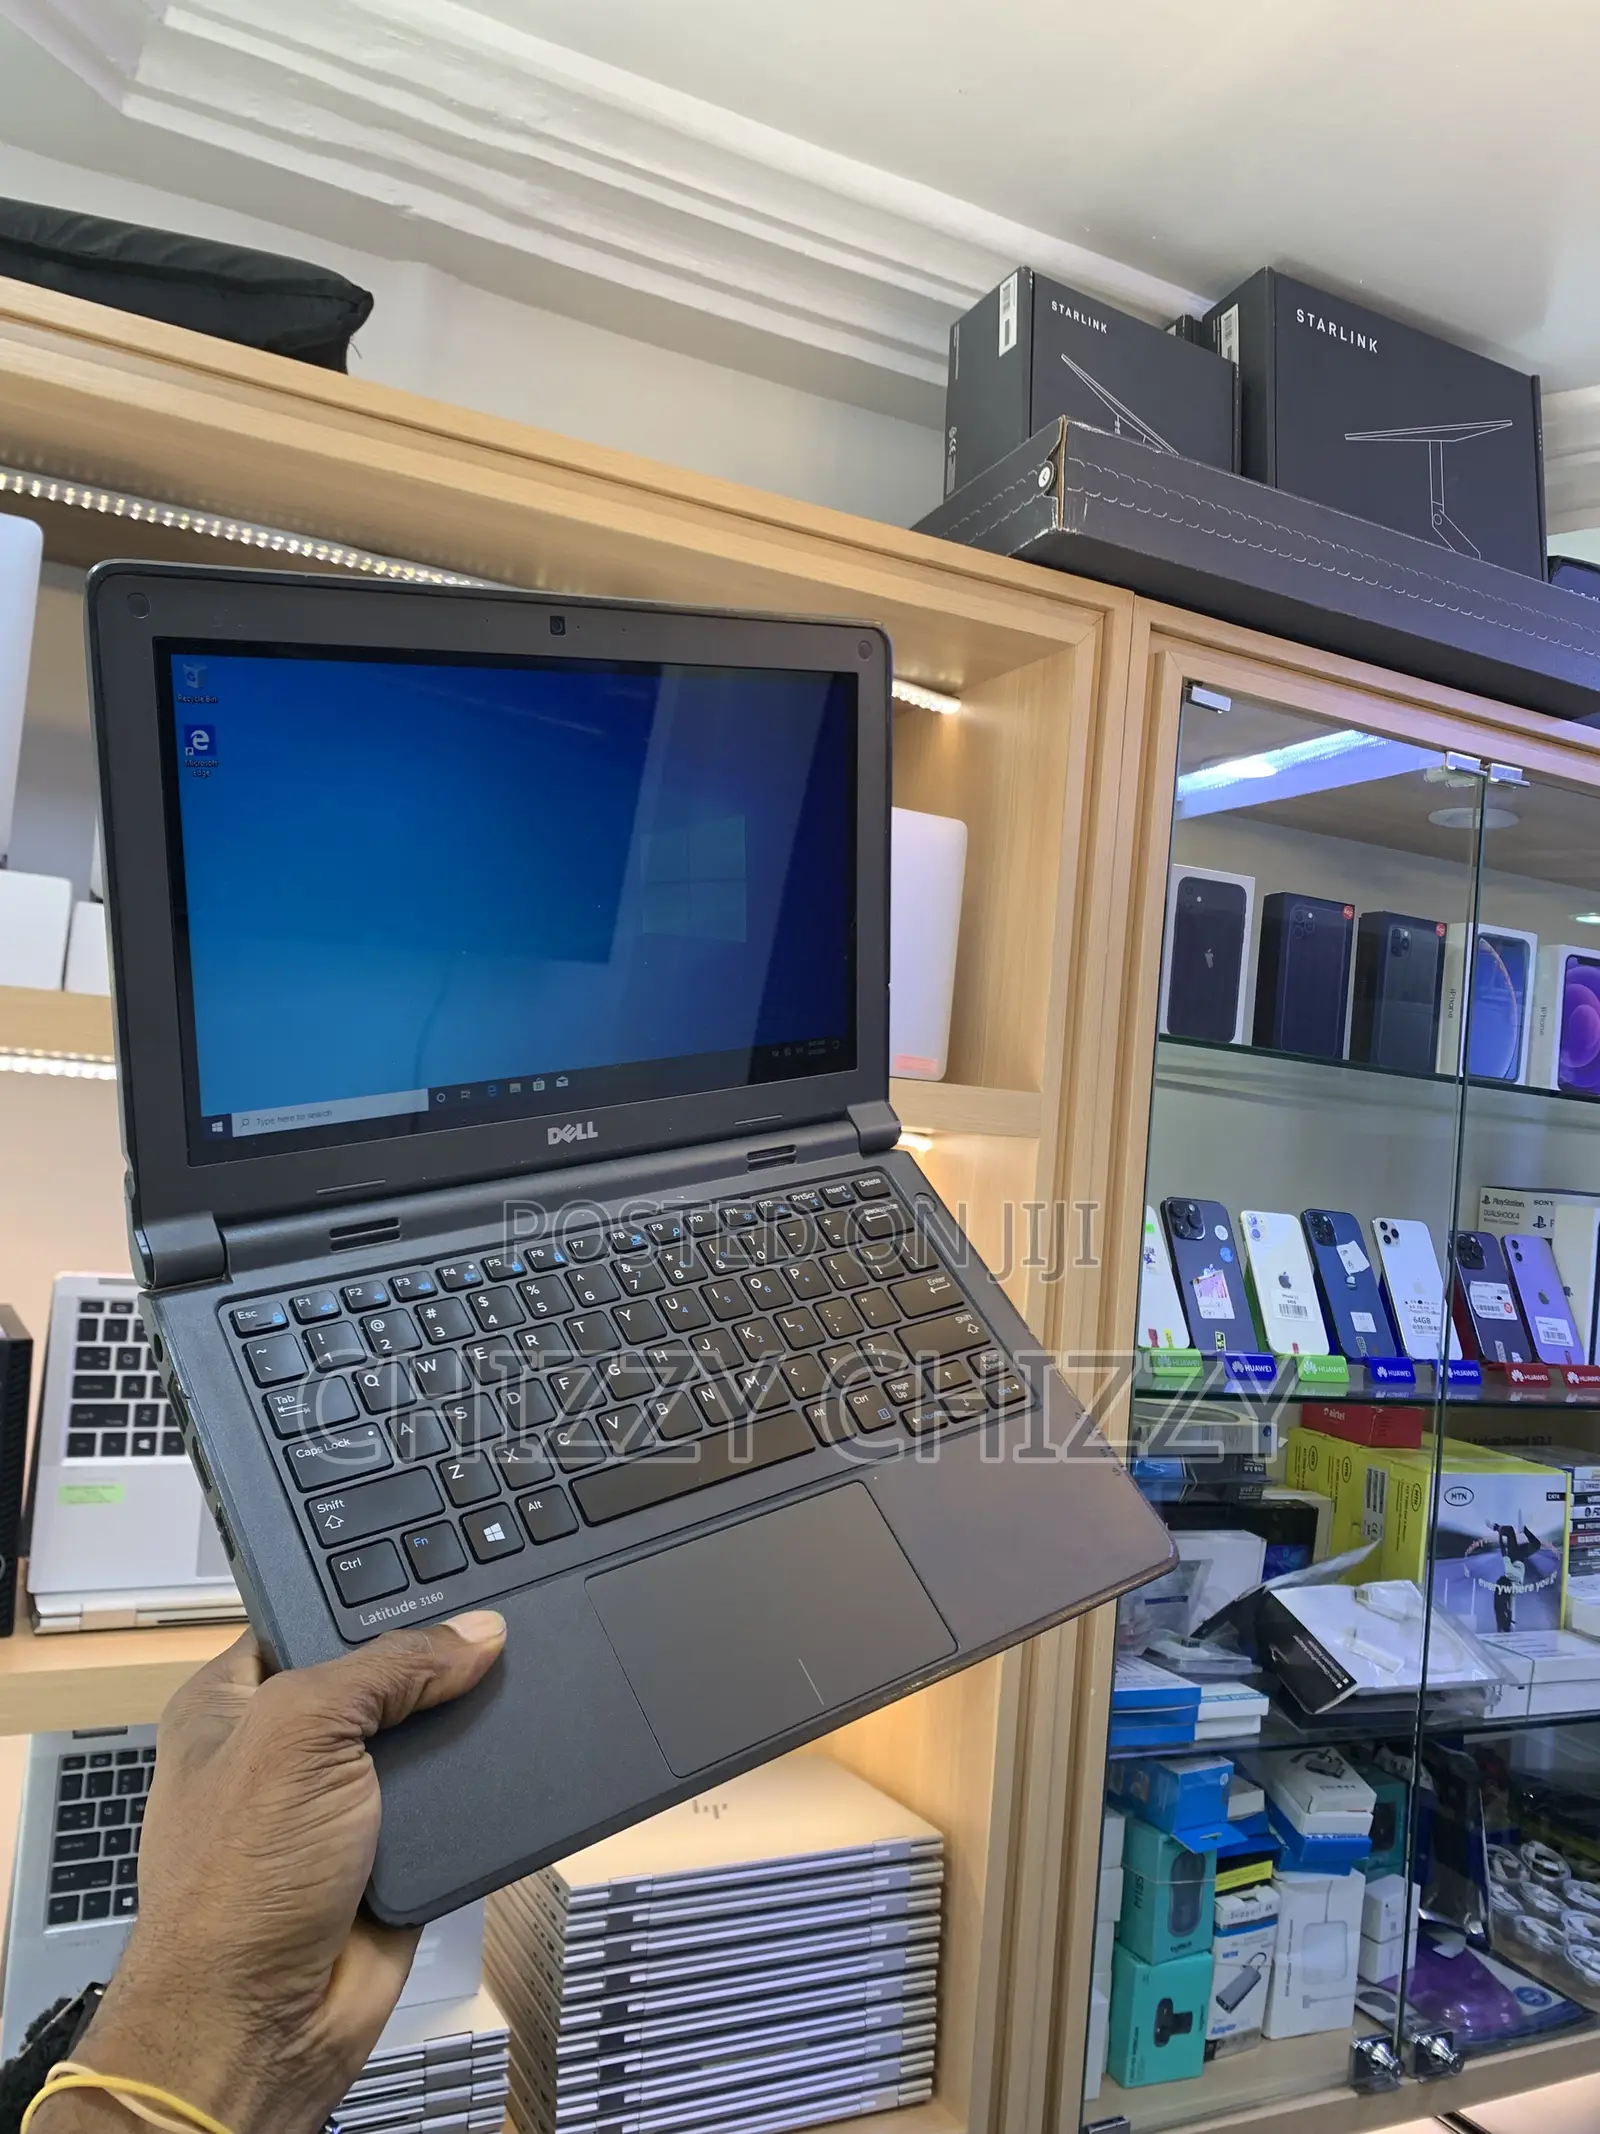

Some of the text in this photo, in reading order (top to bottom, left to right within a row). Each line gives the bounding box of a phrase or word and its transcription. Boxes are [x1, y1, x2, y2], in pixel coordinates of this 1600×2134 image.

[1051, 300, 1108, 334] STARLINK
[1296, 308, 1378, 354] STARLINK
[1447, 988, 1457, 1019] iPhone
[1539, 1006, 1548, 1036] iPhone
[256, 1108, 333, 1129] Type here to search
[547, 1121, 599, 1145] DELL
[859, 1178, 882, 1187] Delete
[825, 1184, 847, 1194] Insert
[791, 1192, 816, 1201] PrtScr
[758, 1200, 773, 1209] F12
[1492, 1197, 1525, 1208] PlayStation
[724, 1208, 738, 1216] F11
[688, 1215, 703, 1224] F10
[651, 1223, 664, 1232] F9
[612, 1231, 625, 1240] F8
[572, 1240, 584, 1249] F7
[531, 1249, 544, 1258] F6
[487, 1258, 501, 1268] F5
[715, 1259, 726, 1269] 9
[442, 1267, 456, 1277] F4
[674, 1269, 684, 1279] 8
[789, 1268, 799, 1280] P
[396, 1278, 410, 1287] F3
[630, 1280, 638, 1289] 7
[750, 1278, 762, 1289] O
[926, 1276, 946, 1286] Enter
[348, 1288, 363, 1297] F2
[584, 1290, 595, 1301] 6
[297, 1298, 311, 1308] F1
[537, 1302, 547, 1312] 5
[665, 1298, 678, 1310] U
[237, 1309, 258, 1321] Esc
[488, 1314, 498, 1325] 4
[620, 1309, 632, 1321] Y
[955, 1314, 974, 1324] Shift
[1413, 1316, 1431, 1325] 64GB
[573, 1321, 585, 1333] T
[782, 1317, 795, 1328] L
[434, 1327, 446, 1337] 3
[741, 1327, 755, 1339] K
[380, 1338, 392, 1350] 2
[525, 1334, 539, 1347] R
[701, 1338, 711, 1350] J
[474, 1347, 488, 1360] E
[653, 1351, 668, 1363] H
[417, 1359, 437, 1374] W
[608, 1364, 621, 1376] G
[1244, 1364, 1273, 1373] HUAWEI
[1317, 1365, 1346, 1374] HUAWEI
[1387, 1369, 1412, 1378] HUAWEI
[1453, 1369, 1480, 1377] HUAWEI
[1524, 1373, 1549, 1381] HUAWEI
[1579, 1374, 1600, 1382] HUAWE
[364, 1374, 380, 1389] Q
[558, 1377, 570, 1390] F
[744, 1375, 759, 1388] M
[891, 1381, 909, 1392] Page
[273, 1394, 295, 1405] Tab
[507, 1392, 521, 1405] D
[701, 1388, 716, 1401] N
[853, 1394, 869, 1404] Ctrl
[896, 1390, 907, 1400] Up
[454, 1406, 467, 1420] S
[655, 1403, 669, 1416] B
[814, 1408, 825, 1417] Alt
[1328, 1408, 1346, 1421] airtel
[606, 1416, 619, 1429] V
[400, 1422, 414, 1436] A
[557, 1432, 571, 1445] C
[296, 1438, 351, 1458] Caps Lock
[504, 1448, 519, 1463] X
[449, 1464, 464, 1480] Z
[1451, 1493, 1468, 1501] MTN
[316, 1499, 345, 1514] Shift
[528, 1501, 543, 1511] Alt
[413, 1536, 428, 1548] Fn
[339, 1557, 362, 1571] Ctrl
[1478, 1577, 1534, 1596] everywhere
[1535, 1577, 1550, 1592] you
[359, 1591, 445, 1627] Latitude 3160
[1230, 1907, 1261, 1920] Support
